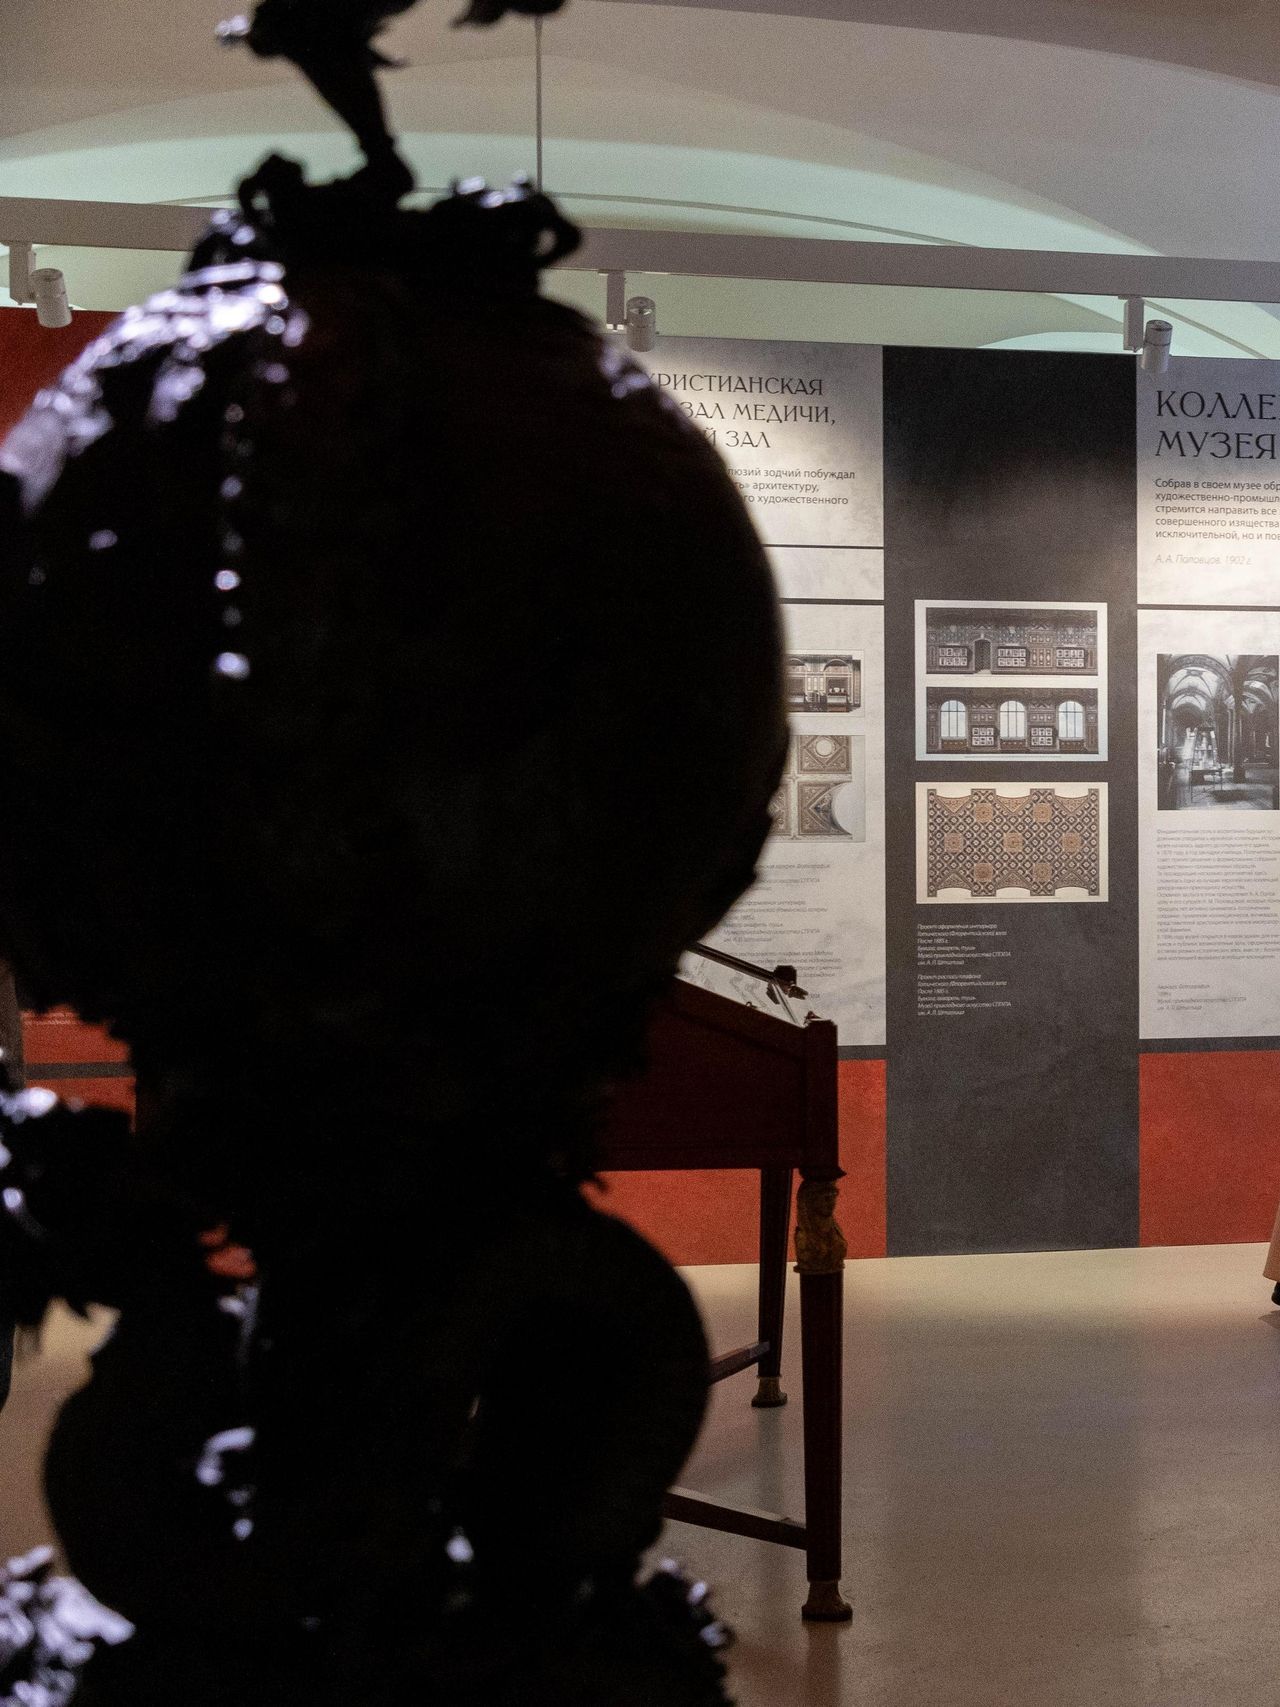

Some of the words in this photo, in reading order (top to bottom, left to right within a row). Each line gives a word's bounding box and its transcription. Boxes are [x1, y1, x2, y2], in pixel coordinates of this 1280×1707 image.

[650, 373, 823, 396] РИСТИАНСКАЯ
[680, 401, 725, 420] ЗАЛ
[732, 403, 836, 426] МЕДИЧИ,
[726, 430, 771, 449] ЗАЛ
[1155, 431, 1277, 460] МУЗЕЯ
[763, 468, 801, 479] зодчий
[803, 469, 856, 481] побуждал
[752, 481, 820, 493] архитектуру,
[1155, 478, 1191, 490] Собрав
[1193, 481, 1199, 489] в
[1201, 481, 1231, 489] своем
[1233, 482, 1262, 492] музее
[757, 495, 849, 505] художественного
[1155, 505, 1206, 515] стремится
[1208, 506, 1259, 516] направить
[1155, 518, 1227, 528] совершенного
[1229, 520, 1280, 529] изящества
[1155, 530, 1240, 541] исключительной,
